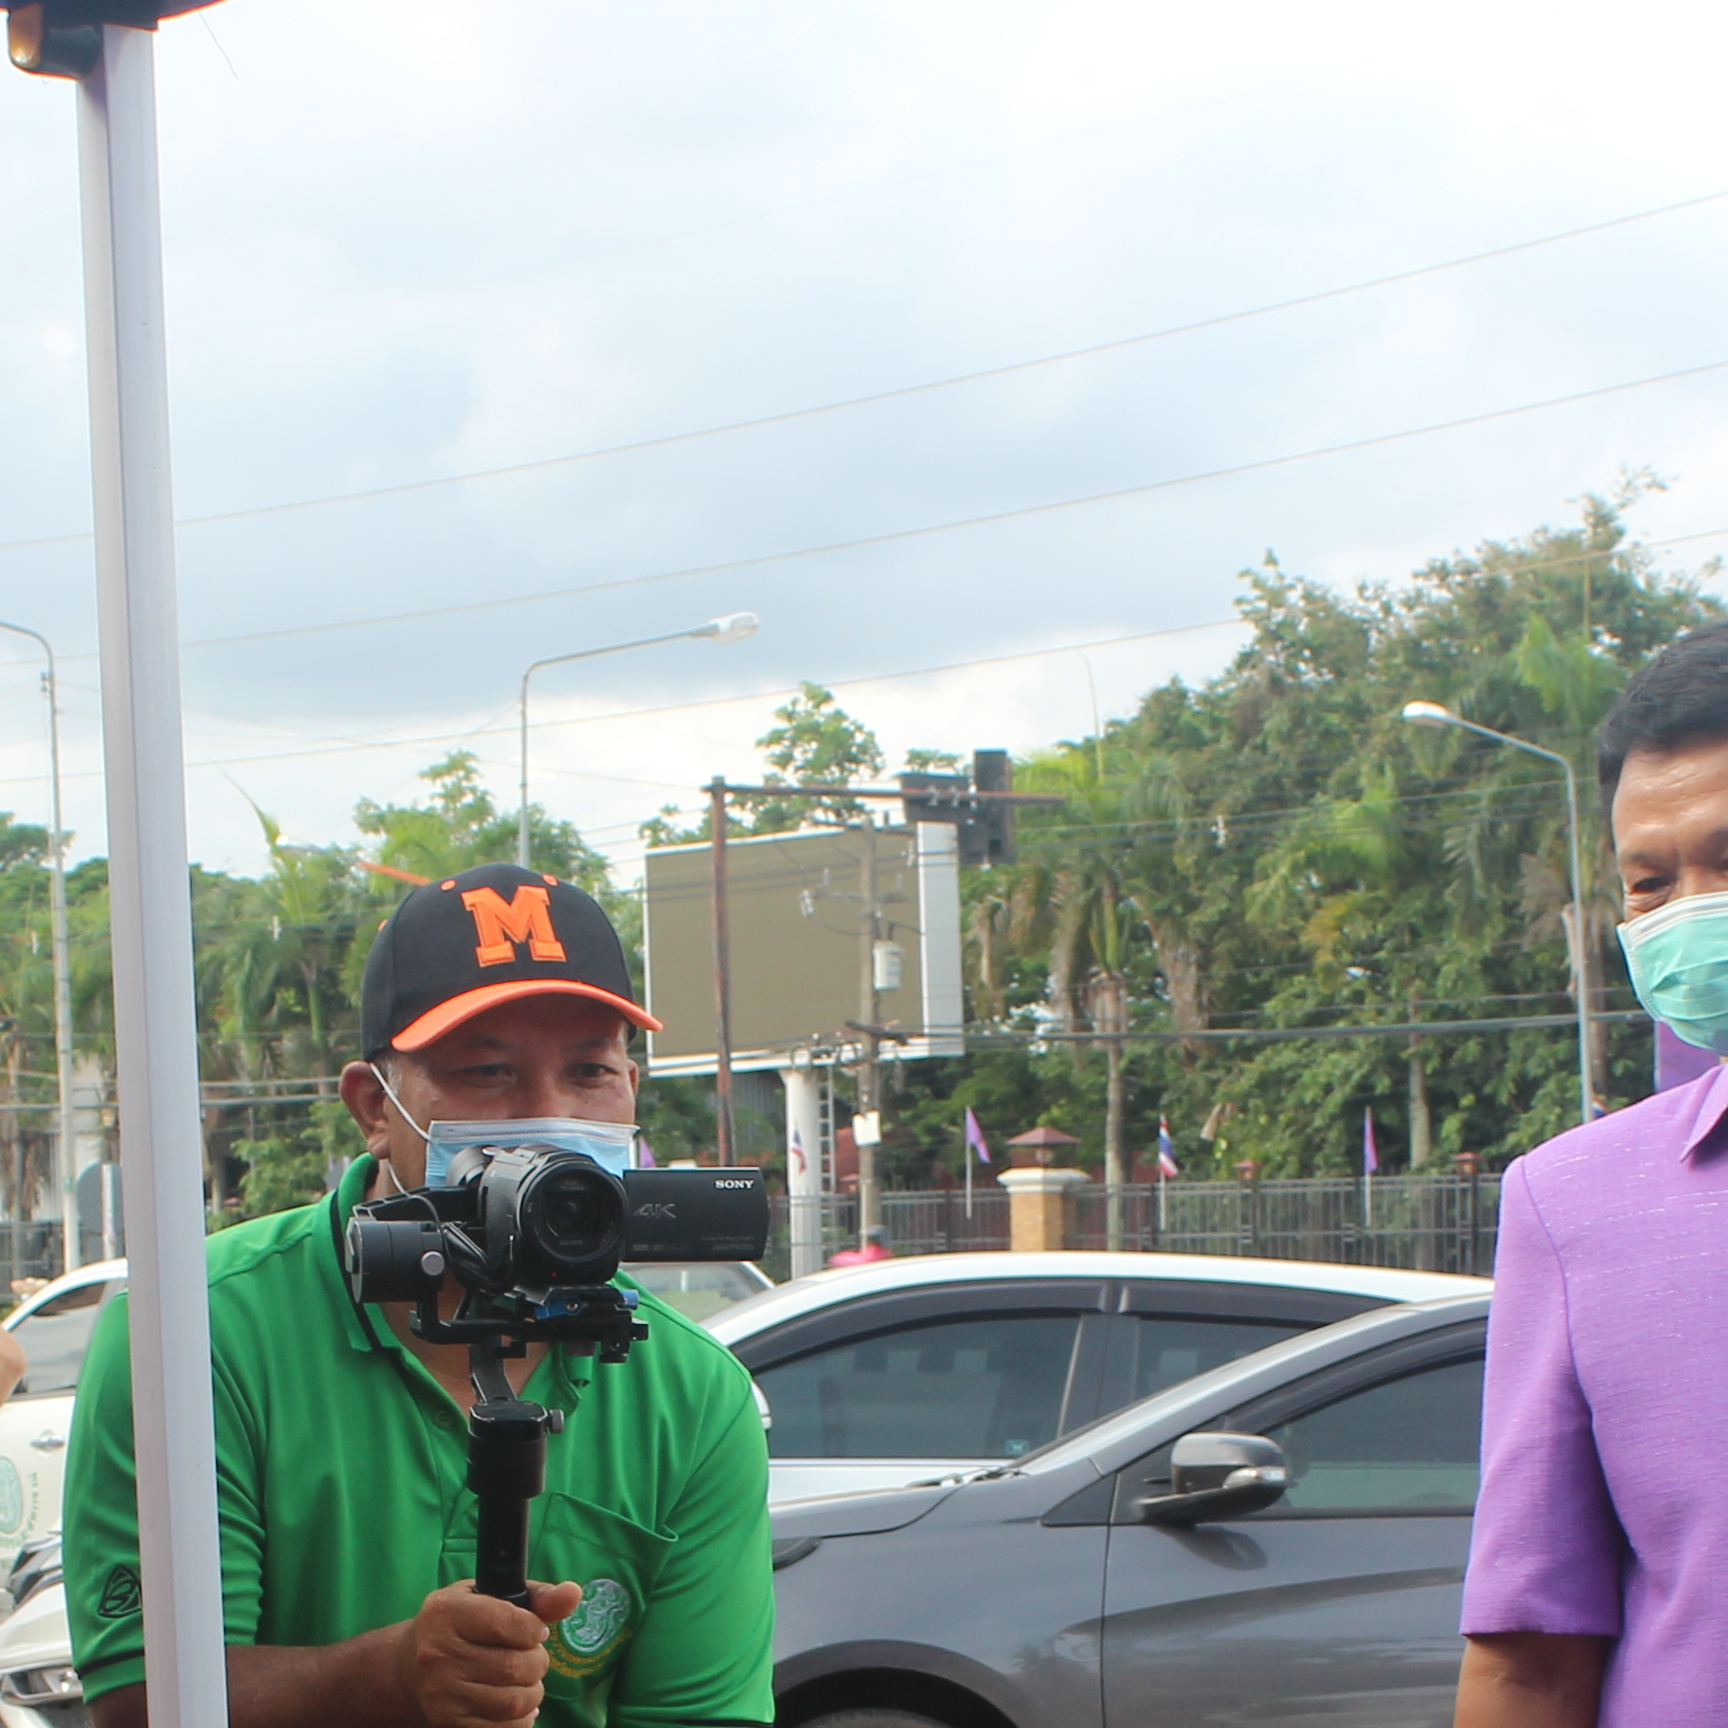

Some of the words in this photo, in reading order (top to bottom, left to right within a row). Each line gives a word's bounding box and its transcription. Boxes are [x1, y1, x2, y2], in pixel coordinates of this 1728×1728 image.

[462, 886, 567, 968] M
[715, 1179, 754, 1189] SONY
[633, 1203, 676, 1219] 4K
